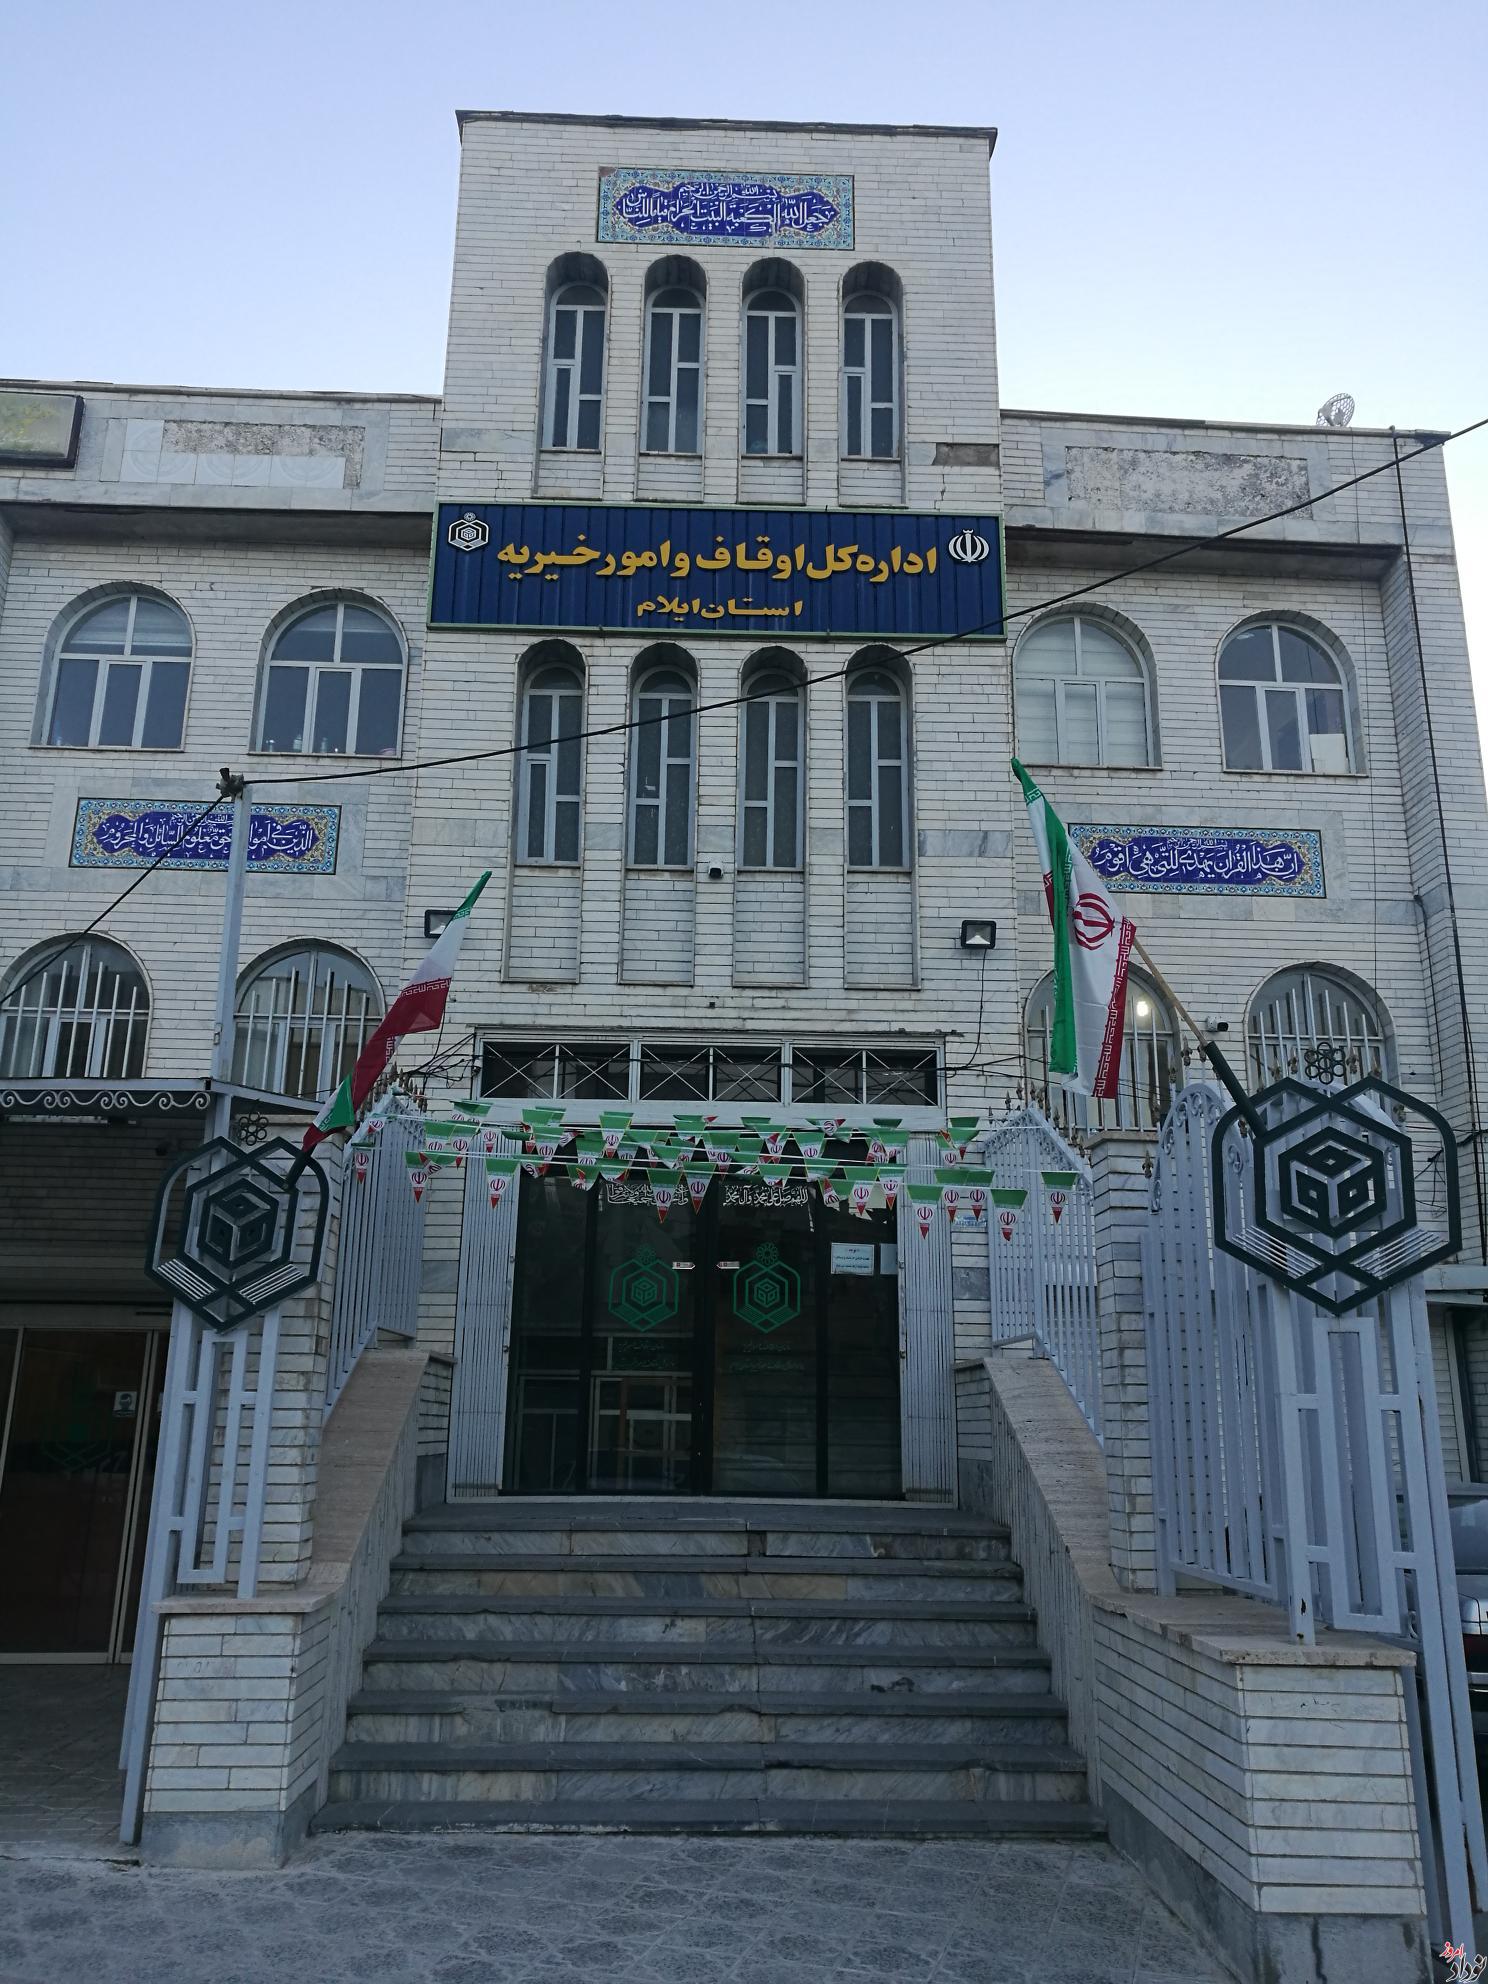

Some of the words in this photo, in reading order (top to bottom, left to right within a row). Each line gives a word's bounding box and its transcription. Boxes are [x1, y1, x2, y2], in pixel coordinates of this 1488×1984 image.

[497, 534, 601, 580] خیریه
[596, 539, 671, 576] امور
[695, 535, 805, 580] اوقاف
[806, 543, 859, 580] کل
[856, 546, 937, 583] اداره
[637, 595, 701, 622] ایلام
[700, 596, 804, 619] استان
